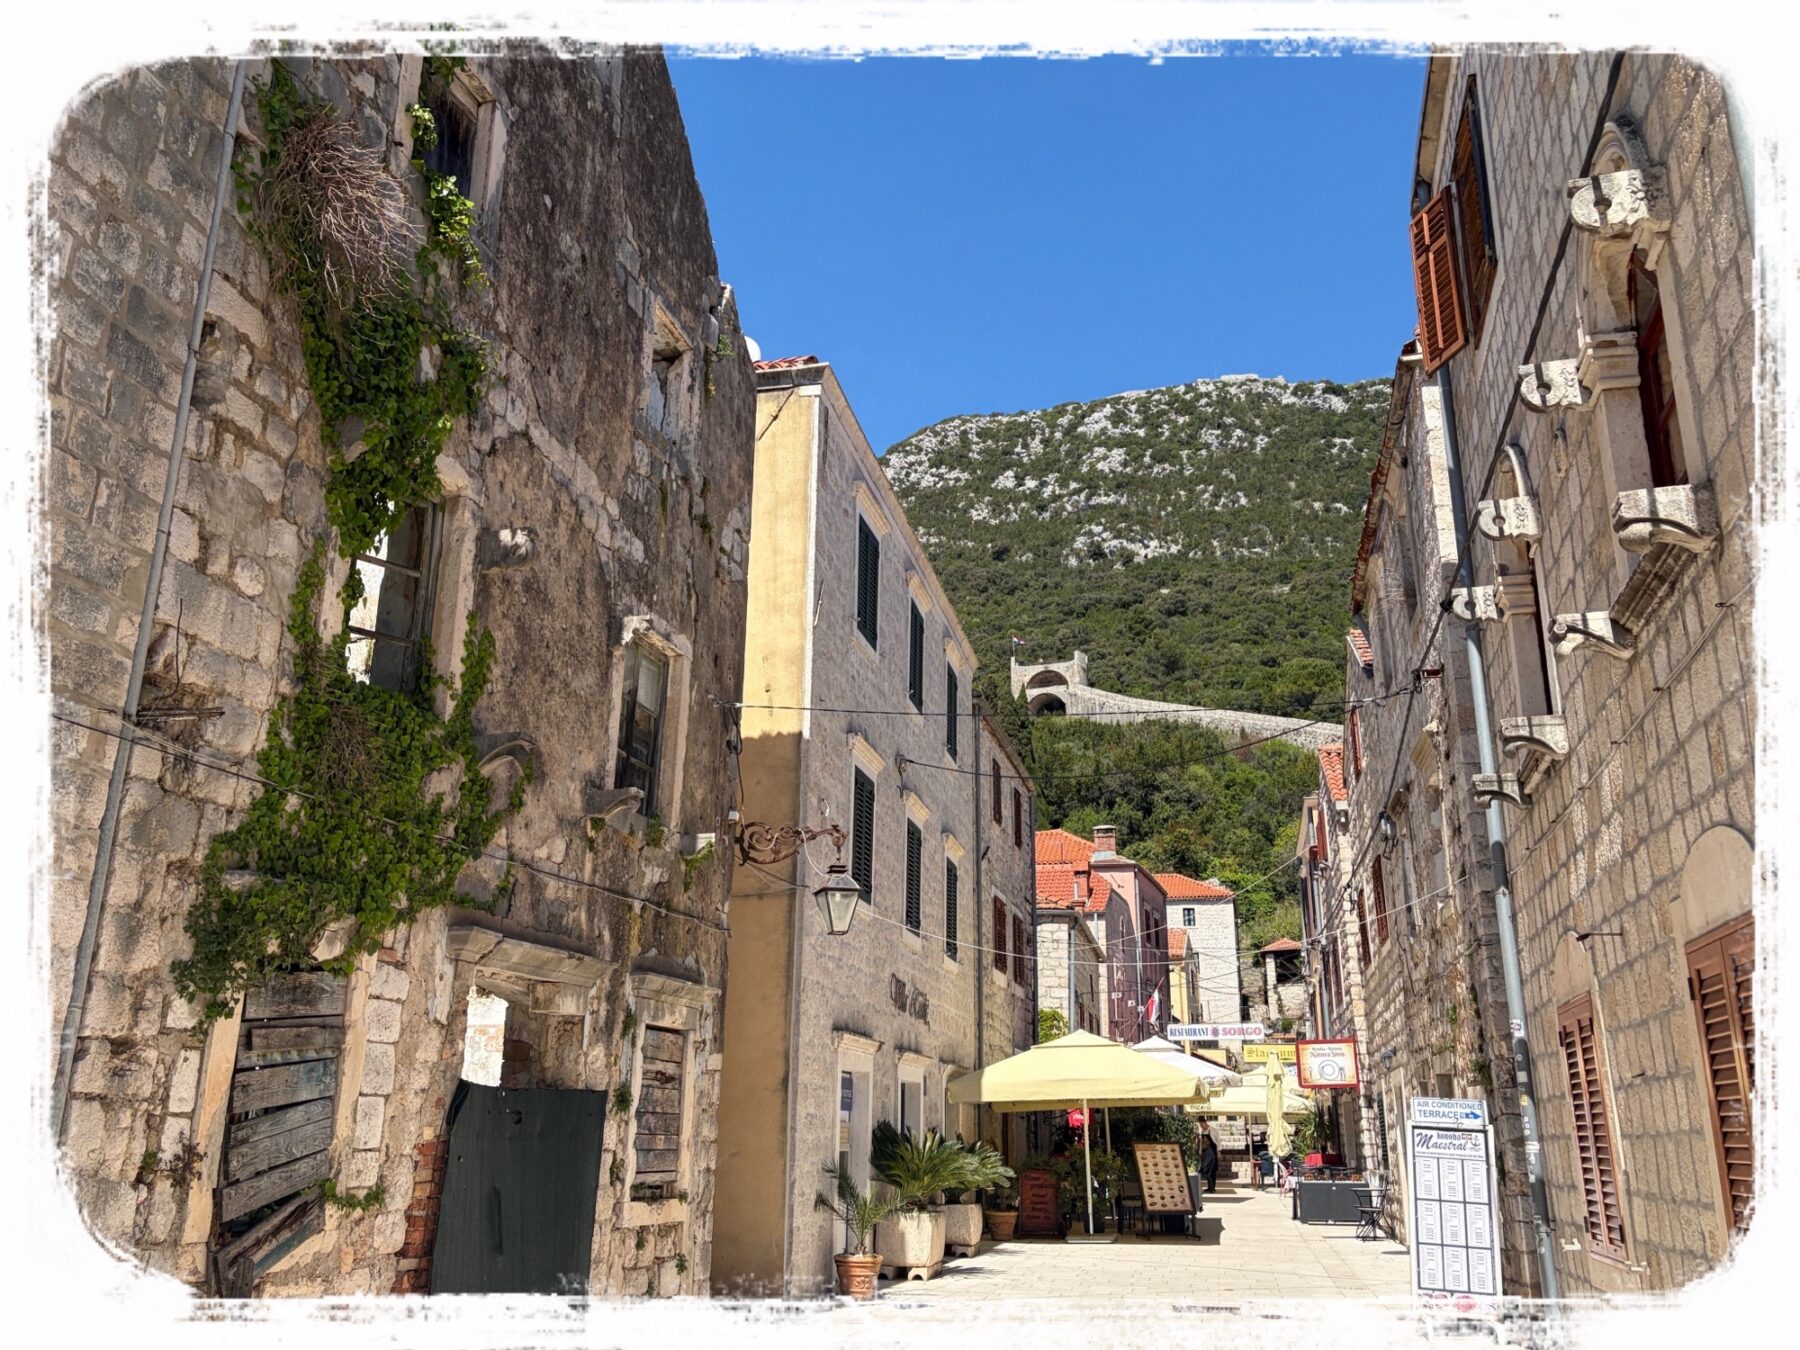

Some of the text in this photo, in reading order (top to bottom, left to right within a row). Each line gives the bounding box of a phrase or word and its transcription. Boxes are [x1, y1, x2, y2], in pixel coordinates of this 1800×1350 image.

[1169, 1026, 1263, 1037] RESTAURANT SORGO
[1416, 1100, 1483, 1110] AIR CONDITIONED
[1417, 1109, 1459, 1119] TERRACE
[1416, 1132, 1469, 1151] Maestral
